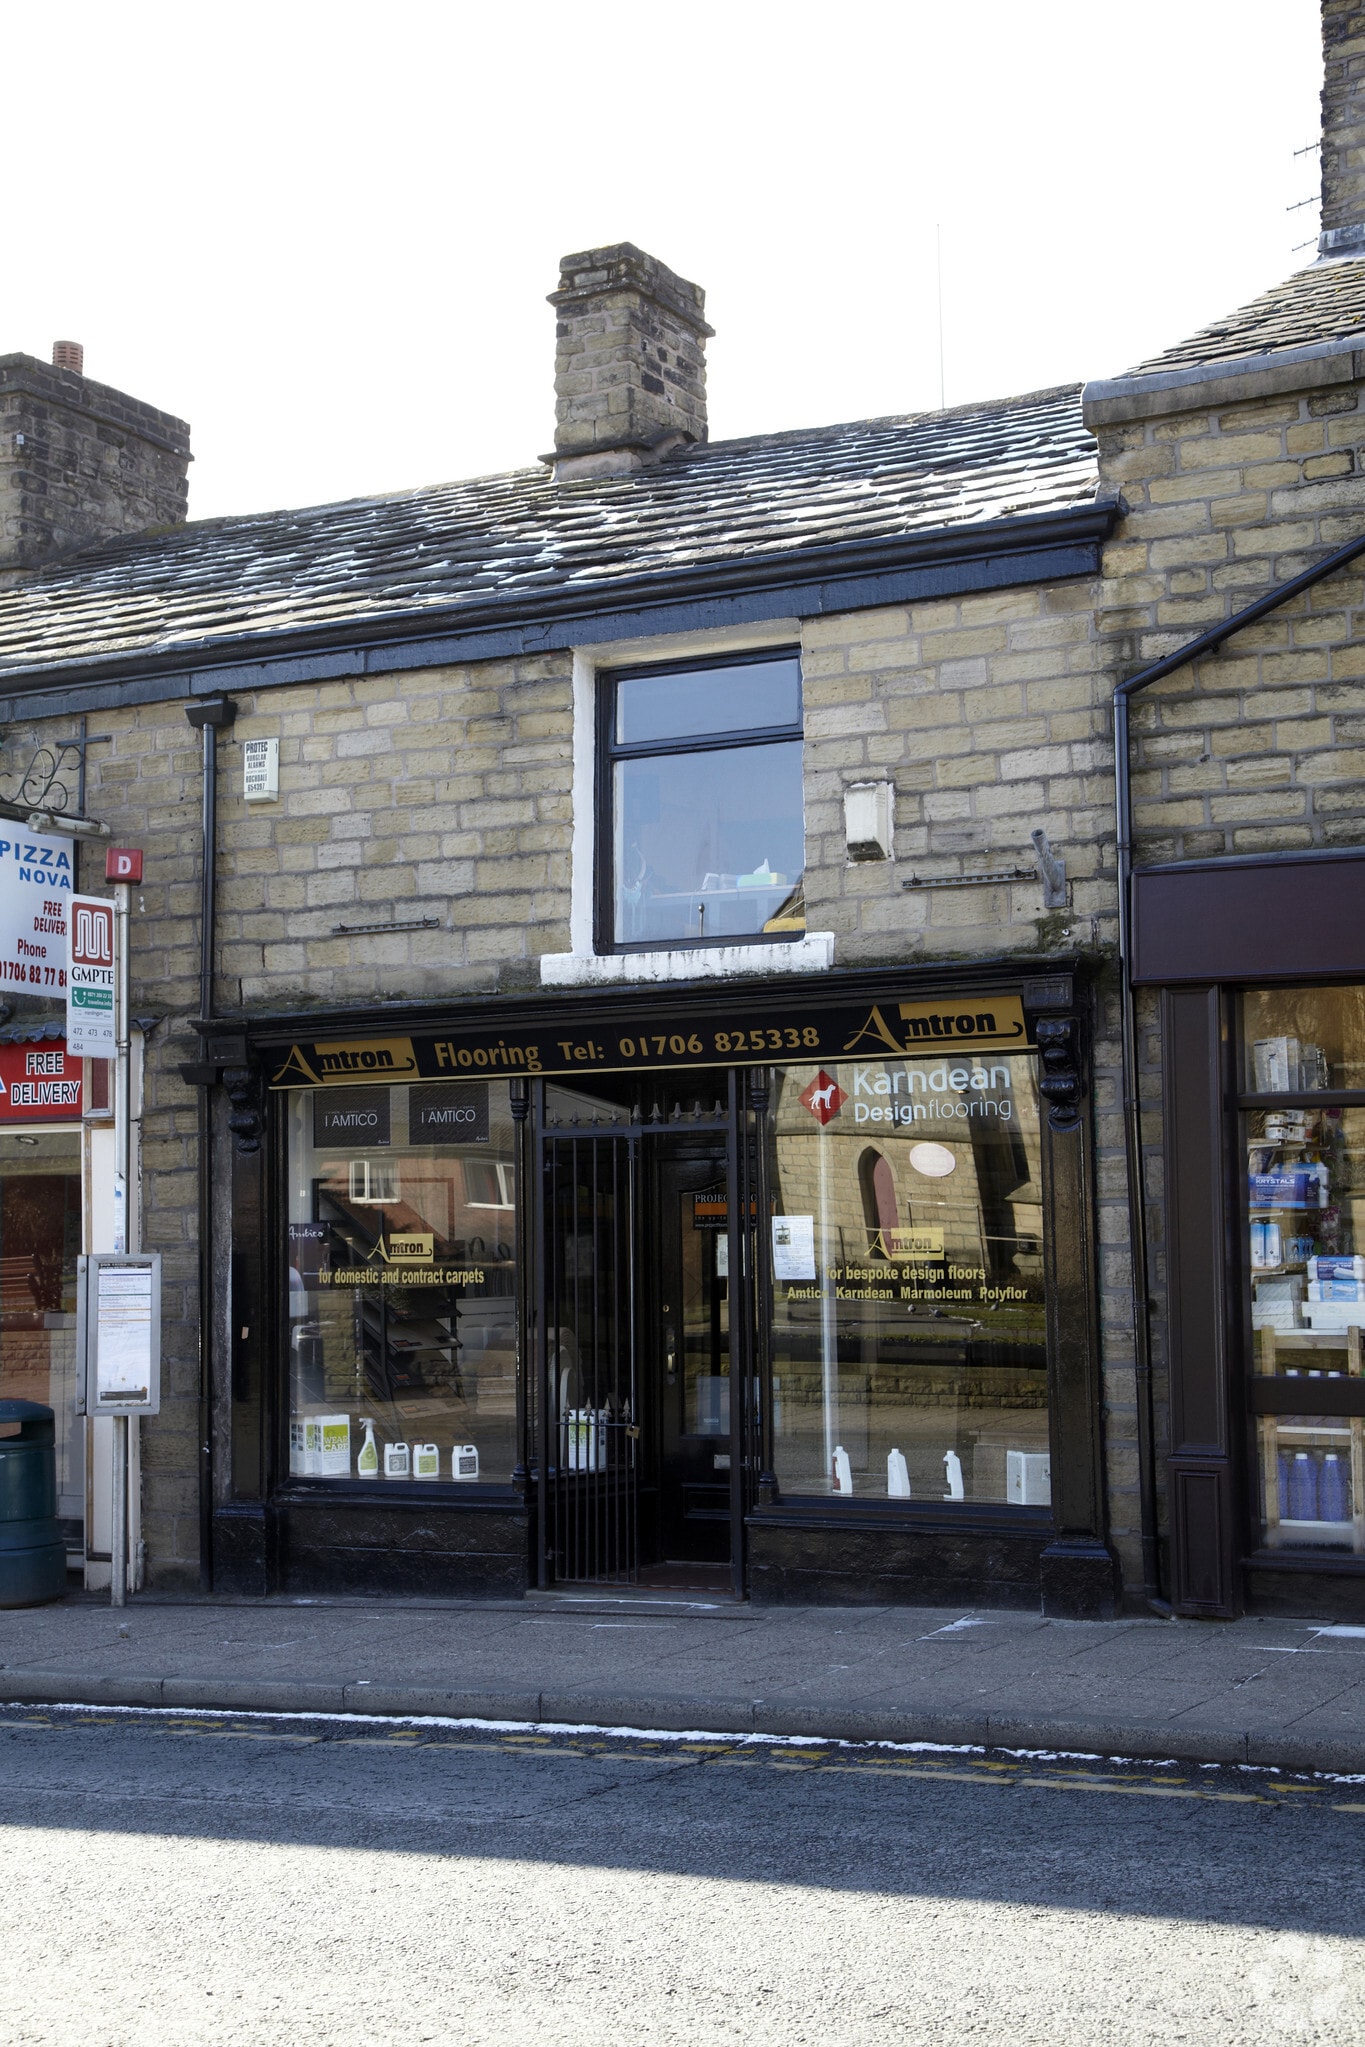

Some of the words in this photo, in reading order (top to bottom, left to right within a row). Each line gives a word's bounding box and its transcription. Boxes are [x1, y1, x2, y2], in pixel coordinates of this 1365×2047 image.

[246, 741, 268, 754] PROTEC
[0, 840, 70, 870] PIZZA
[117, 855, 132, 874] D
[19, 866, 71, 889] NOVA
[43, 900, 62, 917] FREE
[34, 916, 67, 936] DELIVER
[17, 938, 47, 958] Phone
[29, 964, 41, 984] 82
[44, 966, 56, 986] 77
[72, 966, 114, 985] GMPTE
[73, 1027, 83, 1036] 472
[88, 1028, 98, 1037] 473
[102, 1029, 113, 1038] 478
[73, 1042, 84, 1051] 484
[272, 1044, 394, 1084] Amtron
[433, 1040, 543, 1072] Flooring
[557, 1040, 605, 1061] Tel:
[619, 1033, 704, 1058] 01706
[714, 1026, 820, 1052] 825338
[842, 1004, 997, 1053] Amtron
[26, 1051, 64, 1075] FREE
[853, 1062, 1011, 1096] Karndean
[11, 1080, 81, 1106] DELIVERY
[332, 1113, 378, 1127] AMTICO
[428, 1109, 476, 1124] AMTICO
[854, 1096, 1012, 1126] Designflooring
[289, 1225, 324, 1239] Amtico
[367, 1233, 424, 1264] Amtron
[864, 1230, 932, 1261] Amtron
[319, 1268, 332, 1284] for
[334, 1268, 378, 1284] domestic
[381, 1268, 399, 1284] and
[401, 1268, 443, 1284] contract
[446, 1268, 485, 1287] carpets
[826, 1265, 843, 1280] for
[846, 1265, 899, 1283] bespoke
[902, 1265, 945, 1283] design
[949, 1265, 986, 1280] floors
[836, 1286, 894, 1299] Karndean
[900, 1286, 972, 1299] Marmoleum
[979, 1286, 1028, 1302] Polyflor
